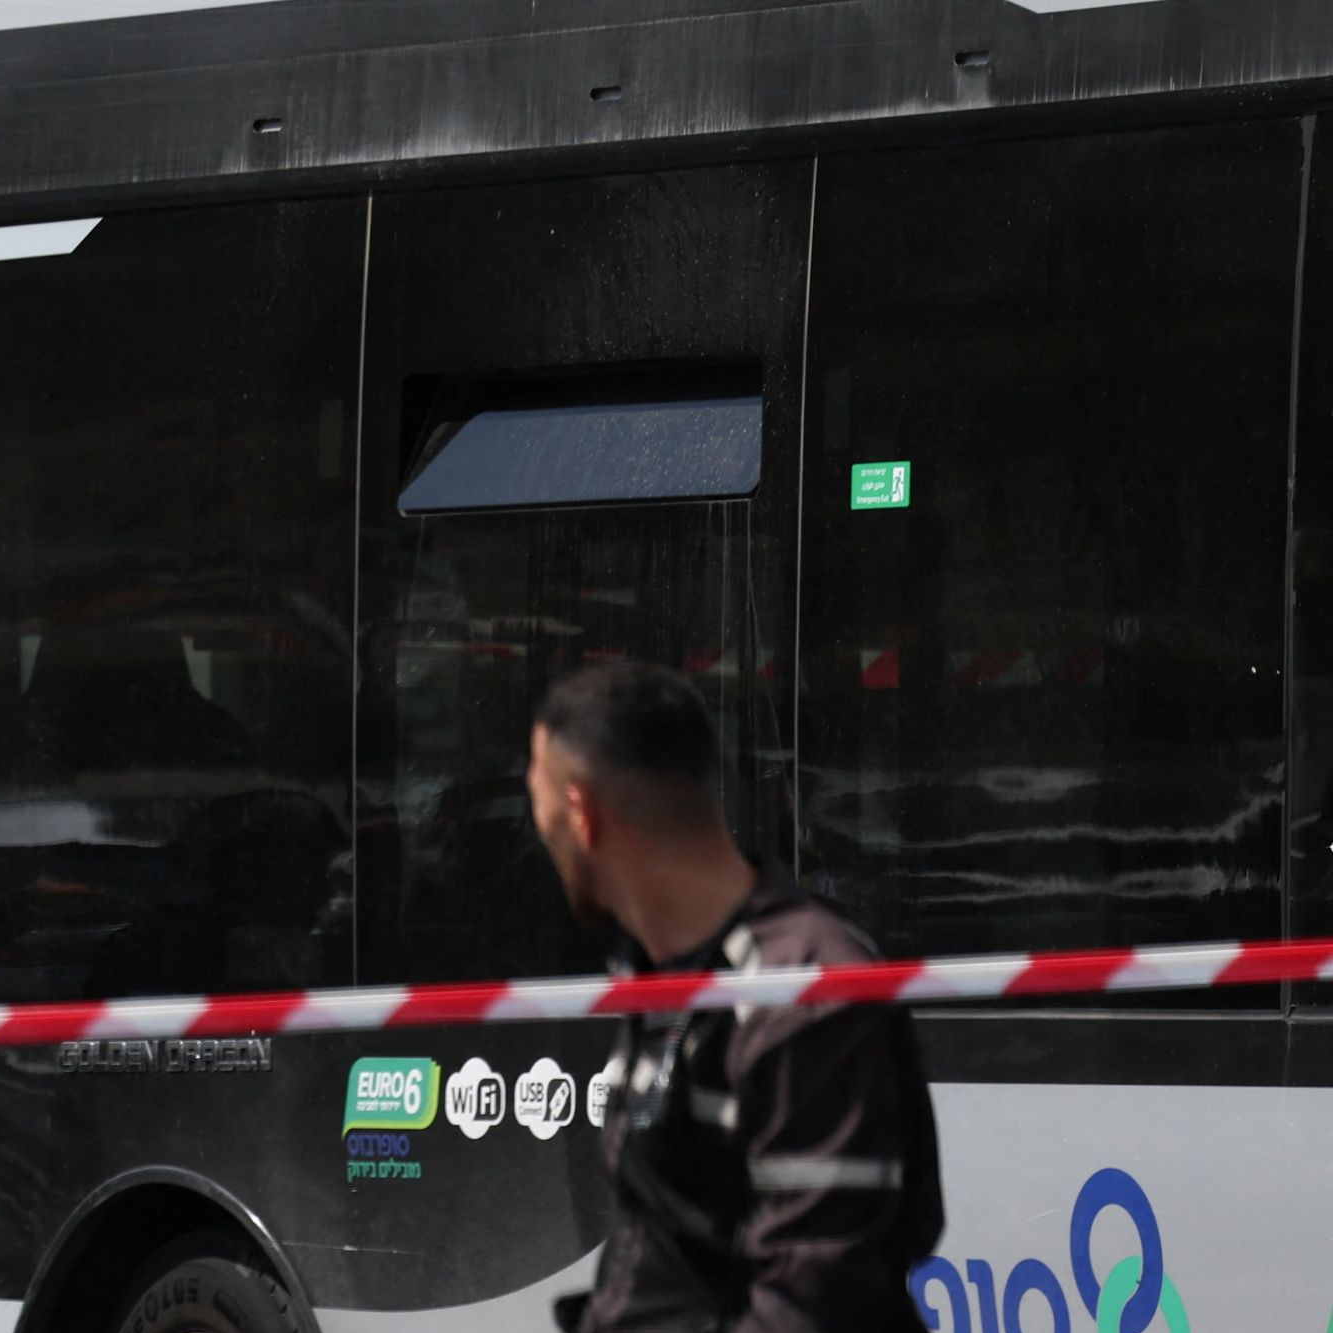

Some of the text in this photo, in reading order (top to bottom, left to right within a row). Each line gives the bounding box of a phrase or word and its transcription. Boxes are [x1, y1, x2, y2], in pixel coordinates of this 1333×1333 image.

[60, 1038, 273, 1073] GOLDEN DRAGON
[357, 1072, 404, 1098] EURO
[519, 1082, 544, 1103] USB
[347, 1134, 410, 1157] סופרבוס
[346, 1157, 422, 1183] מובילים בירוק
